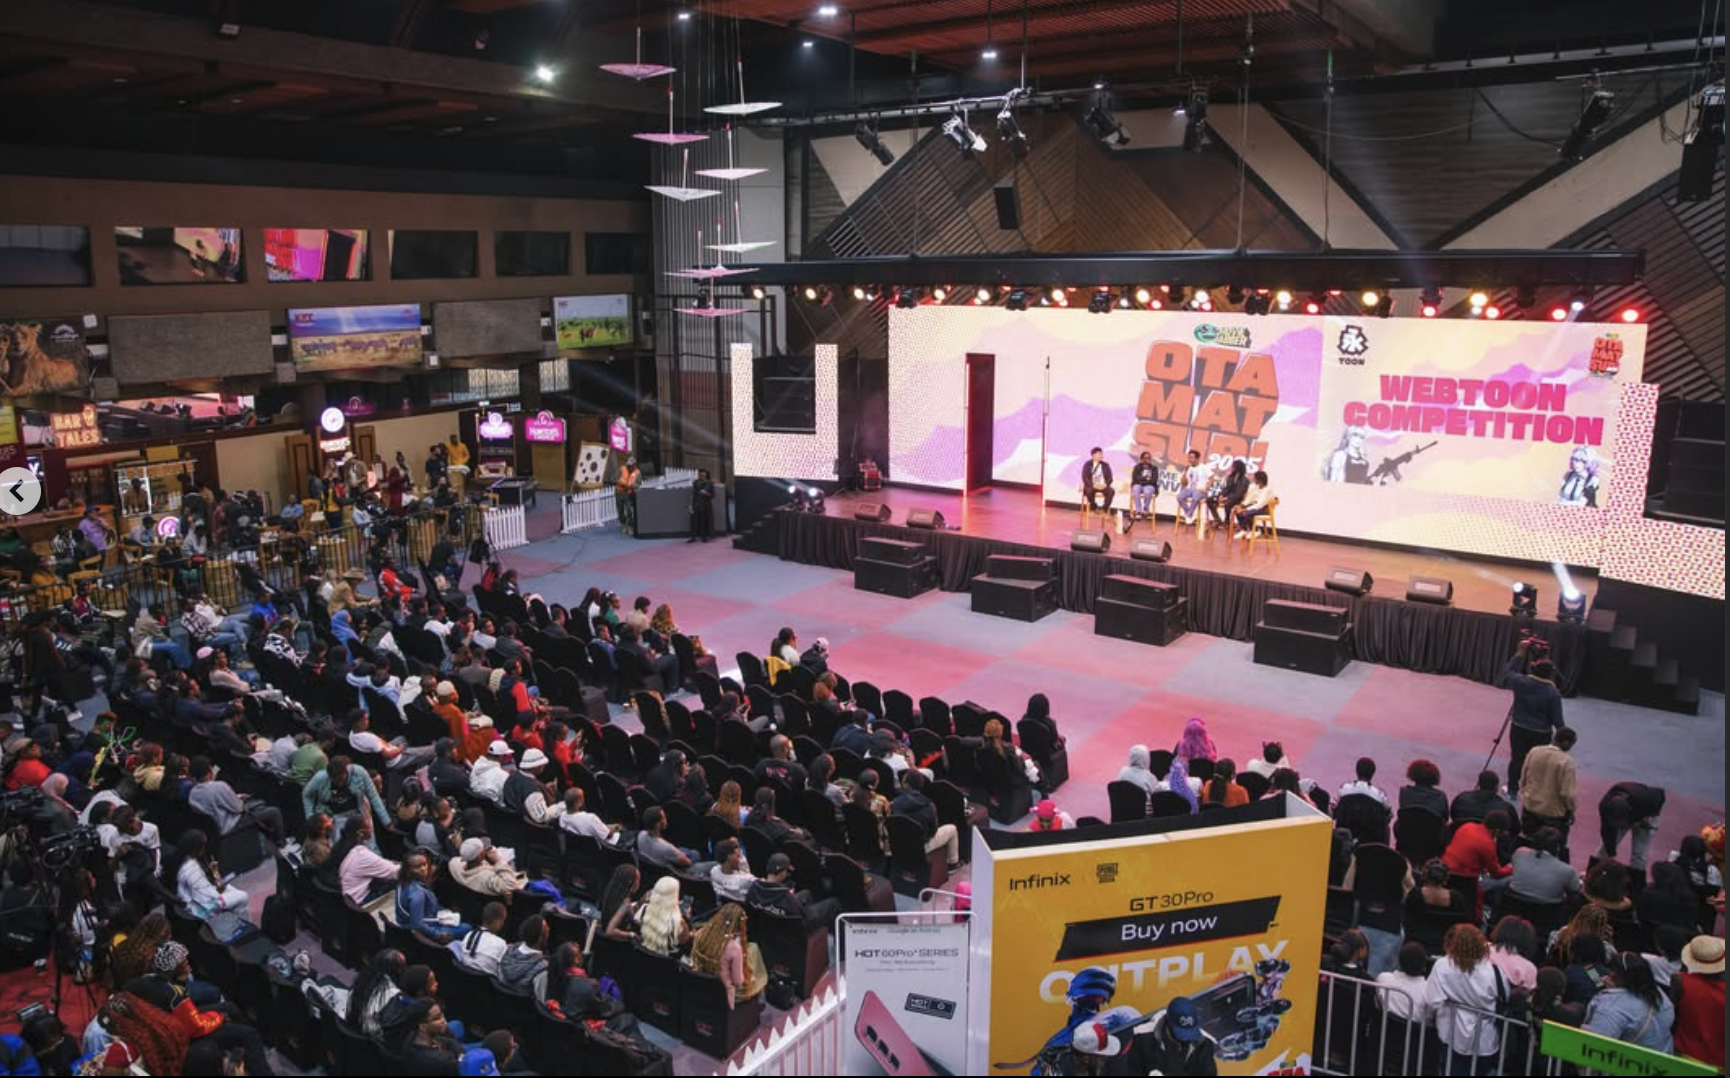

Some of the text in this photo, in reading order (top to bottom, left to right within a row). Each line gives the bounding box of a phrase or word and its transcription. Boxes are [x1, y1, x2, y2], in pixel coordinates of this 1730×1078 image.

[1145, 340, 1279, 398] OTA
[1338, 357, 1366, 366] TOON
[1380, 374, 1567, 412] WEBTOON
[1136, 379, 1279, 438] MAT
[56, 428, 100, 448] TALES
[1343, 402, 1605, 446] COMPETITION
[1010, 872, 1071, 891] Infinix
[1121, 916, 1218, 942] Buy now
[919, 948, 959, 957] SERIES
[1582, 1043, 1669, 1076] Infinix
